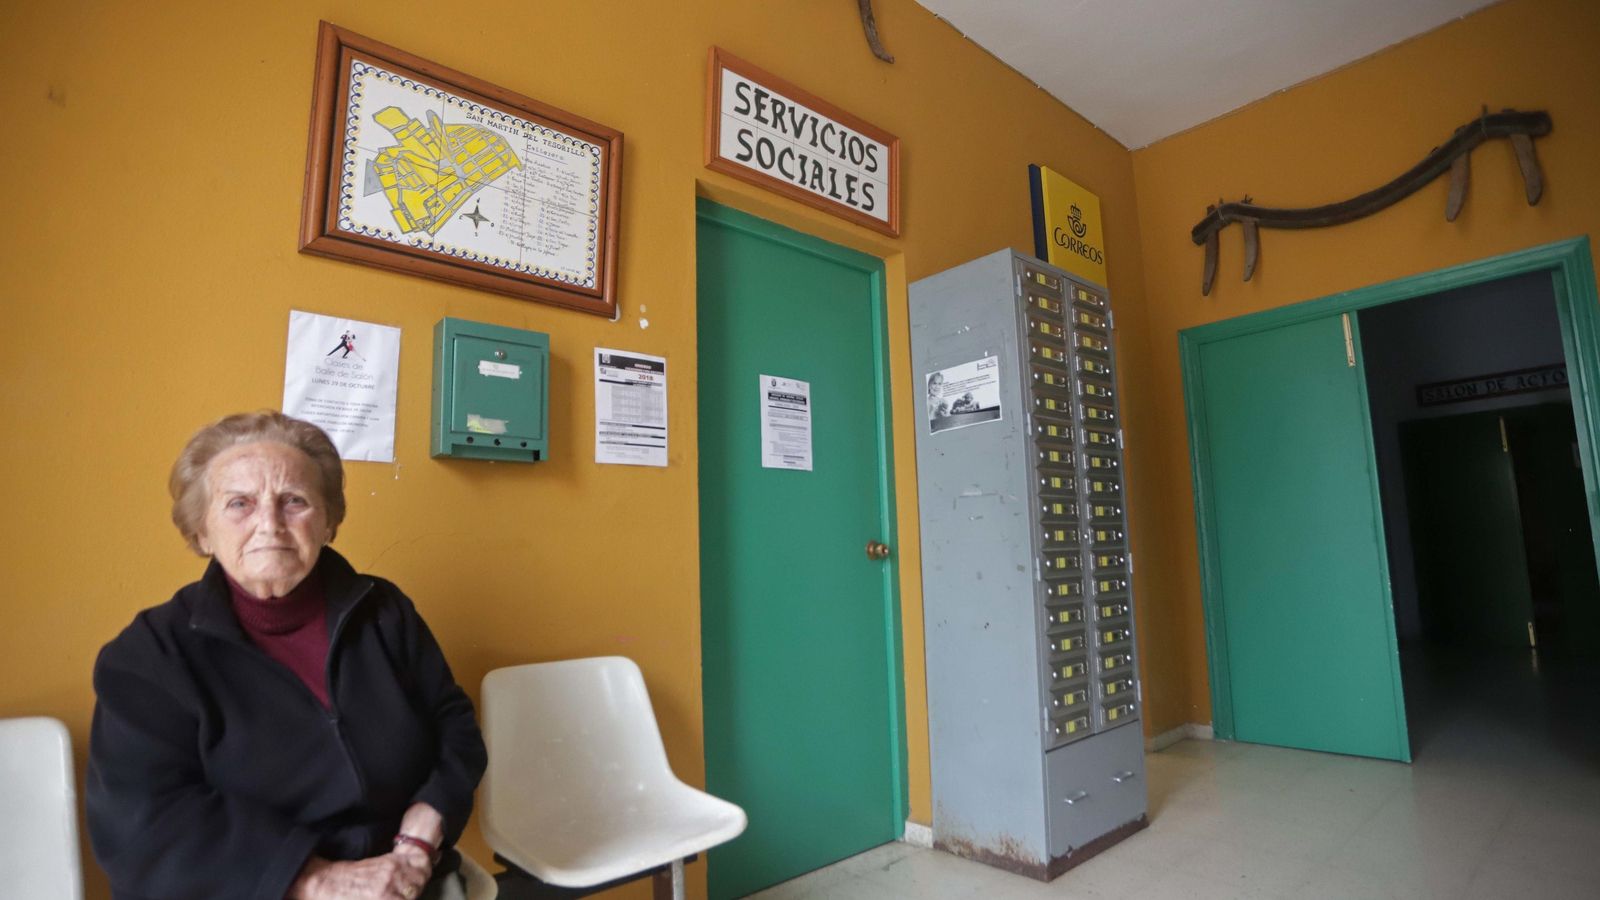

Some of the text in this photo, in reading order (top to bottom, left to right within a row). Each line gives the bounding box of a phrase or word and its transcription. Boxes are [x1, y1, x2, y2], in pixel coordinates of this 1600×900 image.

[465, 112, 585, 158] SAN MARTIN DEL TESORILLO
[734, 81, 878, 174] SERVICIOS
[735, 128, 875, 212] SOCIALES
[1054, 226, 1103, 265] CORREOS
[311, 377, 330, 386] LUNES
[350, 382, 376, 391] OCTUBRE
[638, 373, 654, 382] 2018
[1486, 379, 1507, 392] DE
